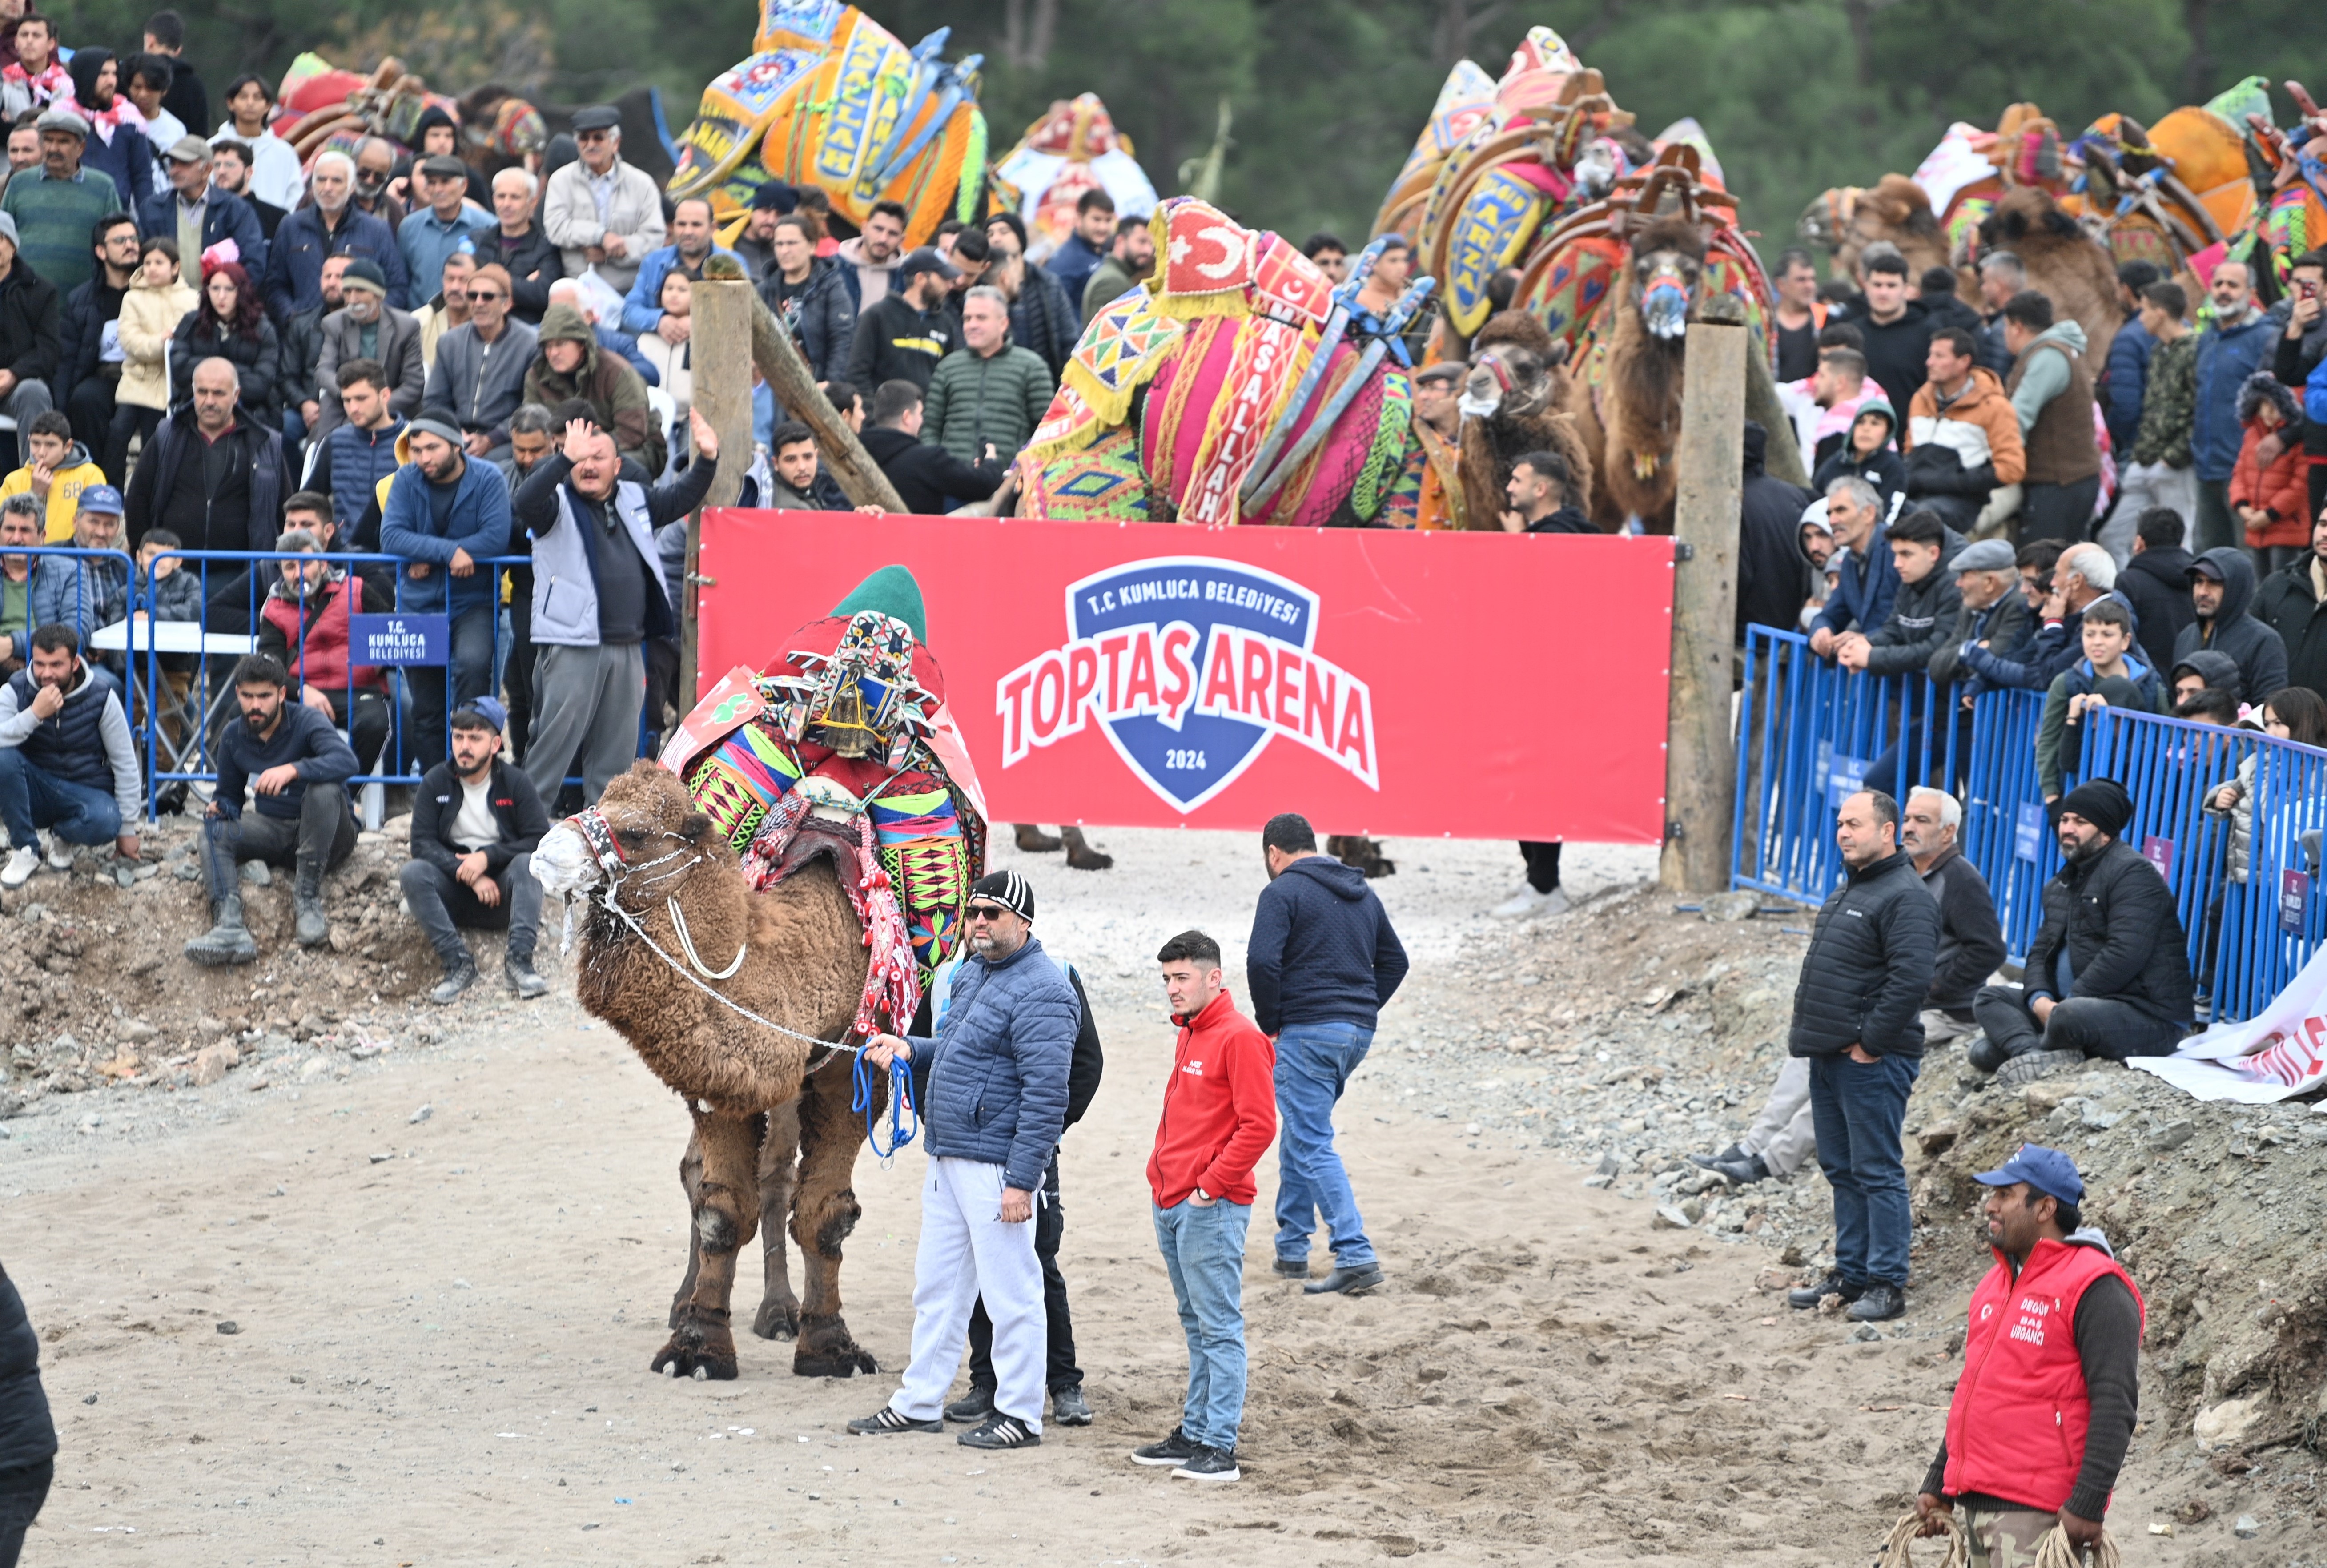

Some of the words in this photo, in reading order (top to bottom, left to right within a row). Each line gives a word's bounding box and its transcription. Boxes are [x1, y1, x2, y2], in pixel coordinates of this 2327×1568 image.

[1118, 579, 1200, 607] KUMLUCA
[387, 620, 406, 634] T.C.
[368, 633, 425, 647] KUMLUCA
[1001, 624, 1197, 763] TOPTAŞ
[1198, 627, 1375, 783] ARENA
[1165, 748, 1206, 770] 2024
[2010, 1323, 2045, 1346] URGANCI
